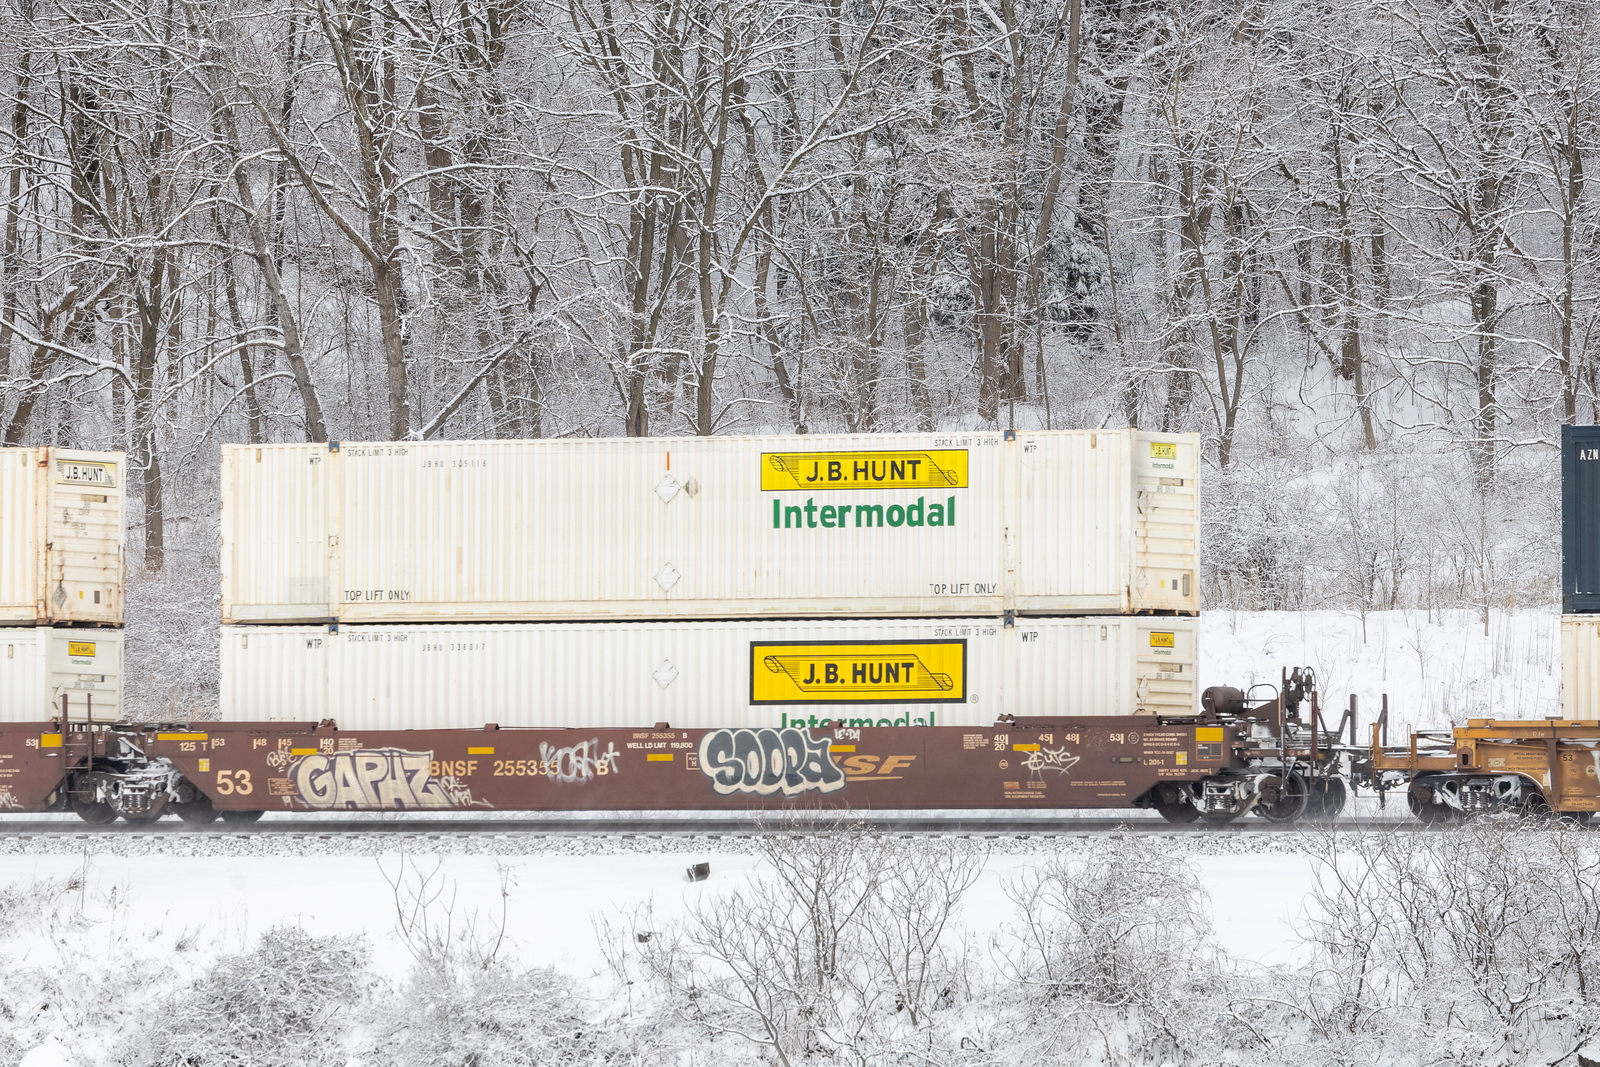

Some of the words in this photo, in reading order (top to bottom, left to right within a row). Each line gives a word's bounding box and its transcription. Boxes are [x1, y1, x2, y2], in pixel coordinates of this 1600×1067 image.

[82, 468, 102, 481] HUNT
[852, 460, 921, 481] HUNT
[773, 496, 955, 528] Intermodal
[345, 590, 361, 600] TOP
[366, 590, 384, 600] LIFT
[389, 590, 409, 600] ONLY
[930, 583, 946, 594] TOP
[951, 583, 969, 594] LIFT
[975, 583, 996, 594] ONLY
[306, 639, 322, 649] WTP
[1022, 632, 1038, 642] WTP
[803, 664, 845, 684] J.B.
[852, 663, 914, 683] HUNT
[179, 742, 196, 751] 125
[201, 742, 208, 751] T
[429, 760, 478, 776] BNSF
[494, 760, 560, 776] 255355
[597, 760, 609, 776] B
[829, 755, 916, 774] SF
[216, 770, 253, 795] 53
